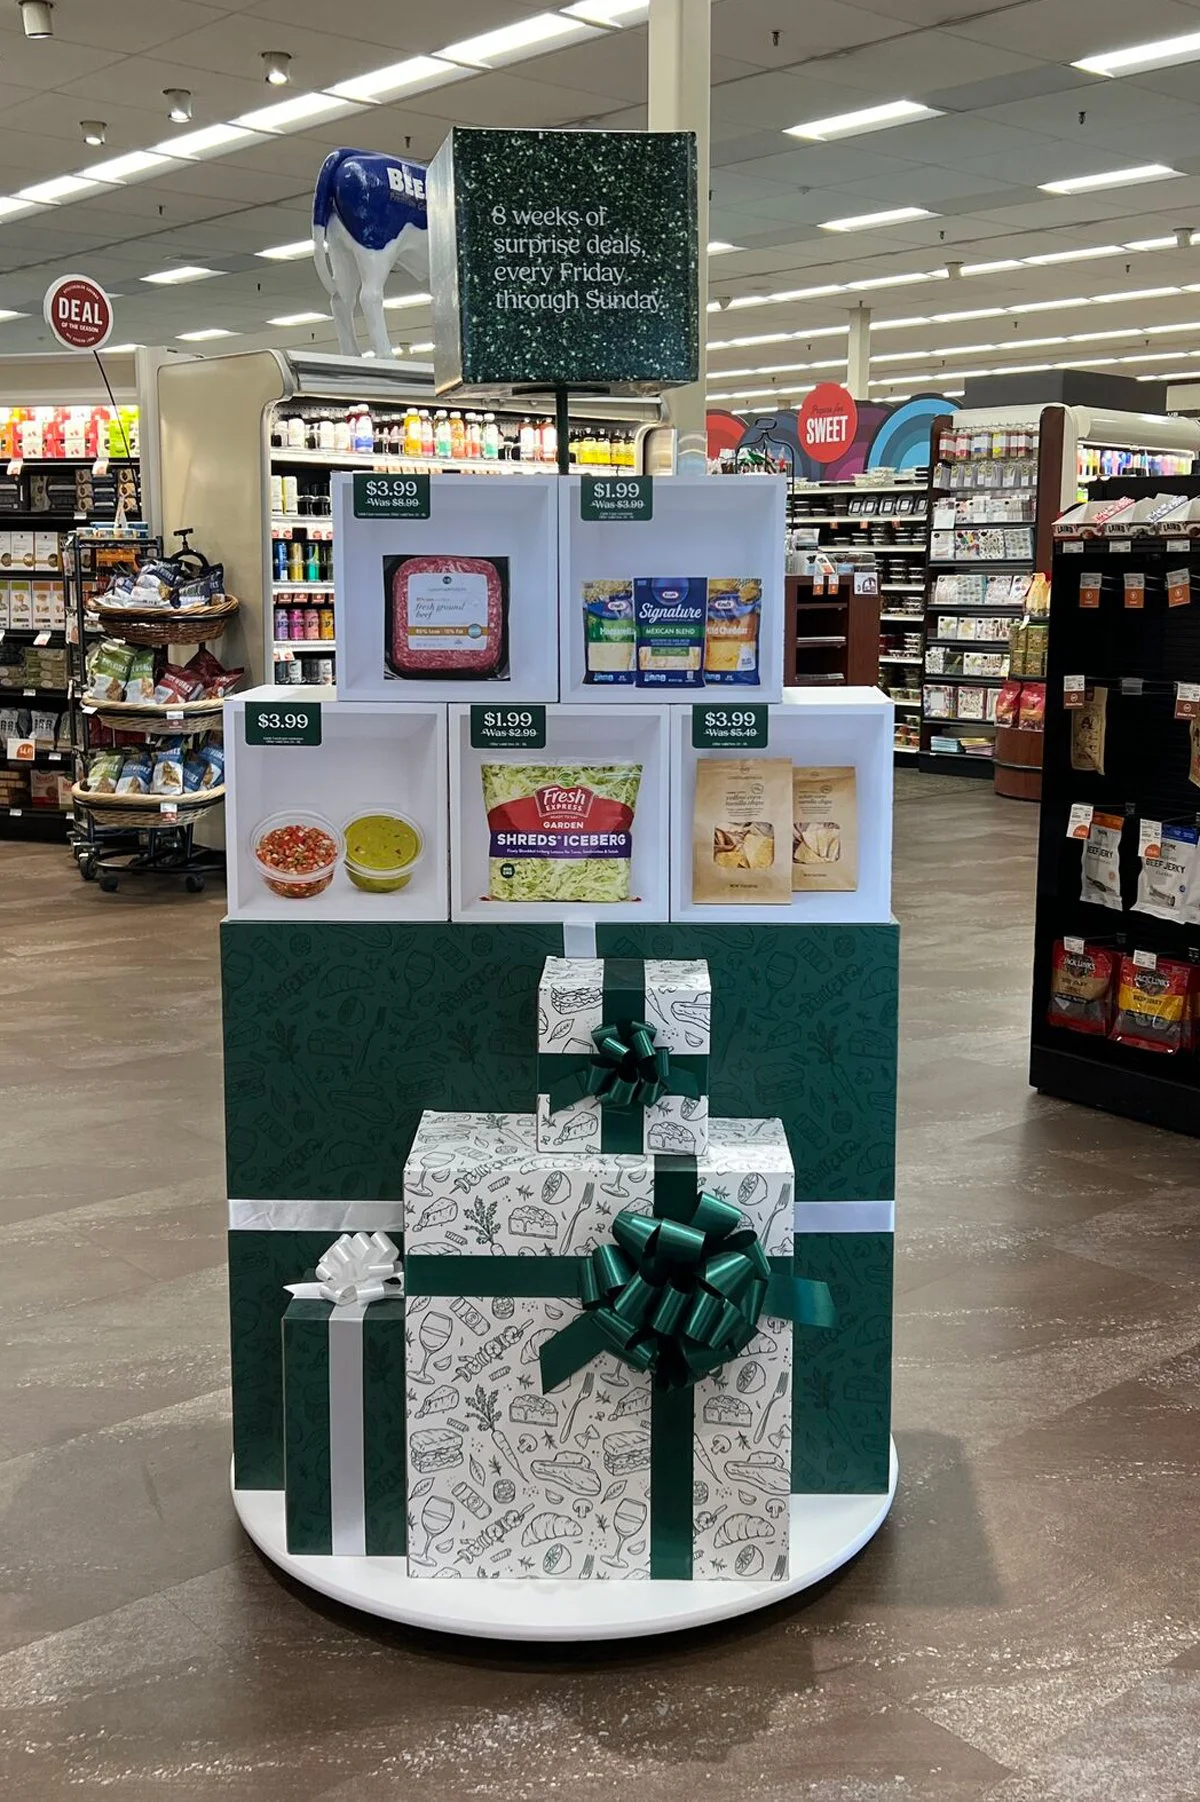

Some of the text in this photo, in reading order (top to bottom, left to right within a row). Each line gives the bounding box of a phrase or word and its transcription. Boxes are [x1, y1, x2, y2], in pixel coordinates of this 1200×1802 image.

[492, 205, 608, 227] 8 weeks of
[493, 234, 646, 258] surprise deals,
[494, 262, 626, 286] every Friday
[496, 289, 662, 313] through Sunday
[58, 296, 103, 326] DEAL
[806, 415, 848, 445] SWEET
[366, 480, 417, 496] $3.99
[593, 482, 640, 498] $1.99
[366, 497, 419, 507] Was $8.99
[592, 499, 644, 509] Was $3.99
[639, 602, 702, 624] Signature
[258, 713, 309, 729] $3.99
[484, 712, 532, 727] $1.99
[705, 711, 756, 727] $3.99
[482, 728, 537, 737] Was $2.99
[705, 728, 757, 737] Was $5.49
[543, 787, 585, 806] Fresh
[545, 804, 583, 812] EXPRESS
[564, 834, 626, 846] ICEBERG
[1145, 857, 1186, 874] BEEF JERKY
